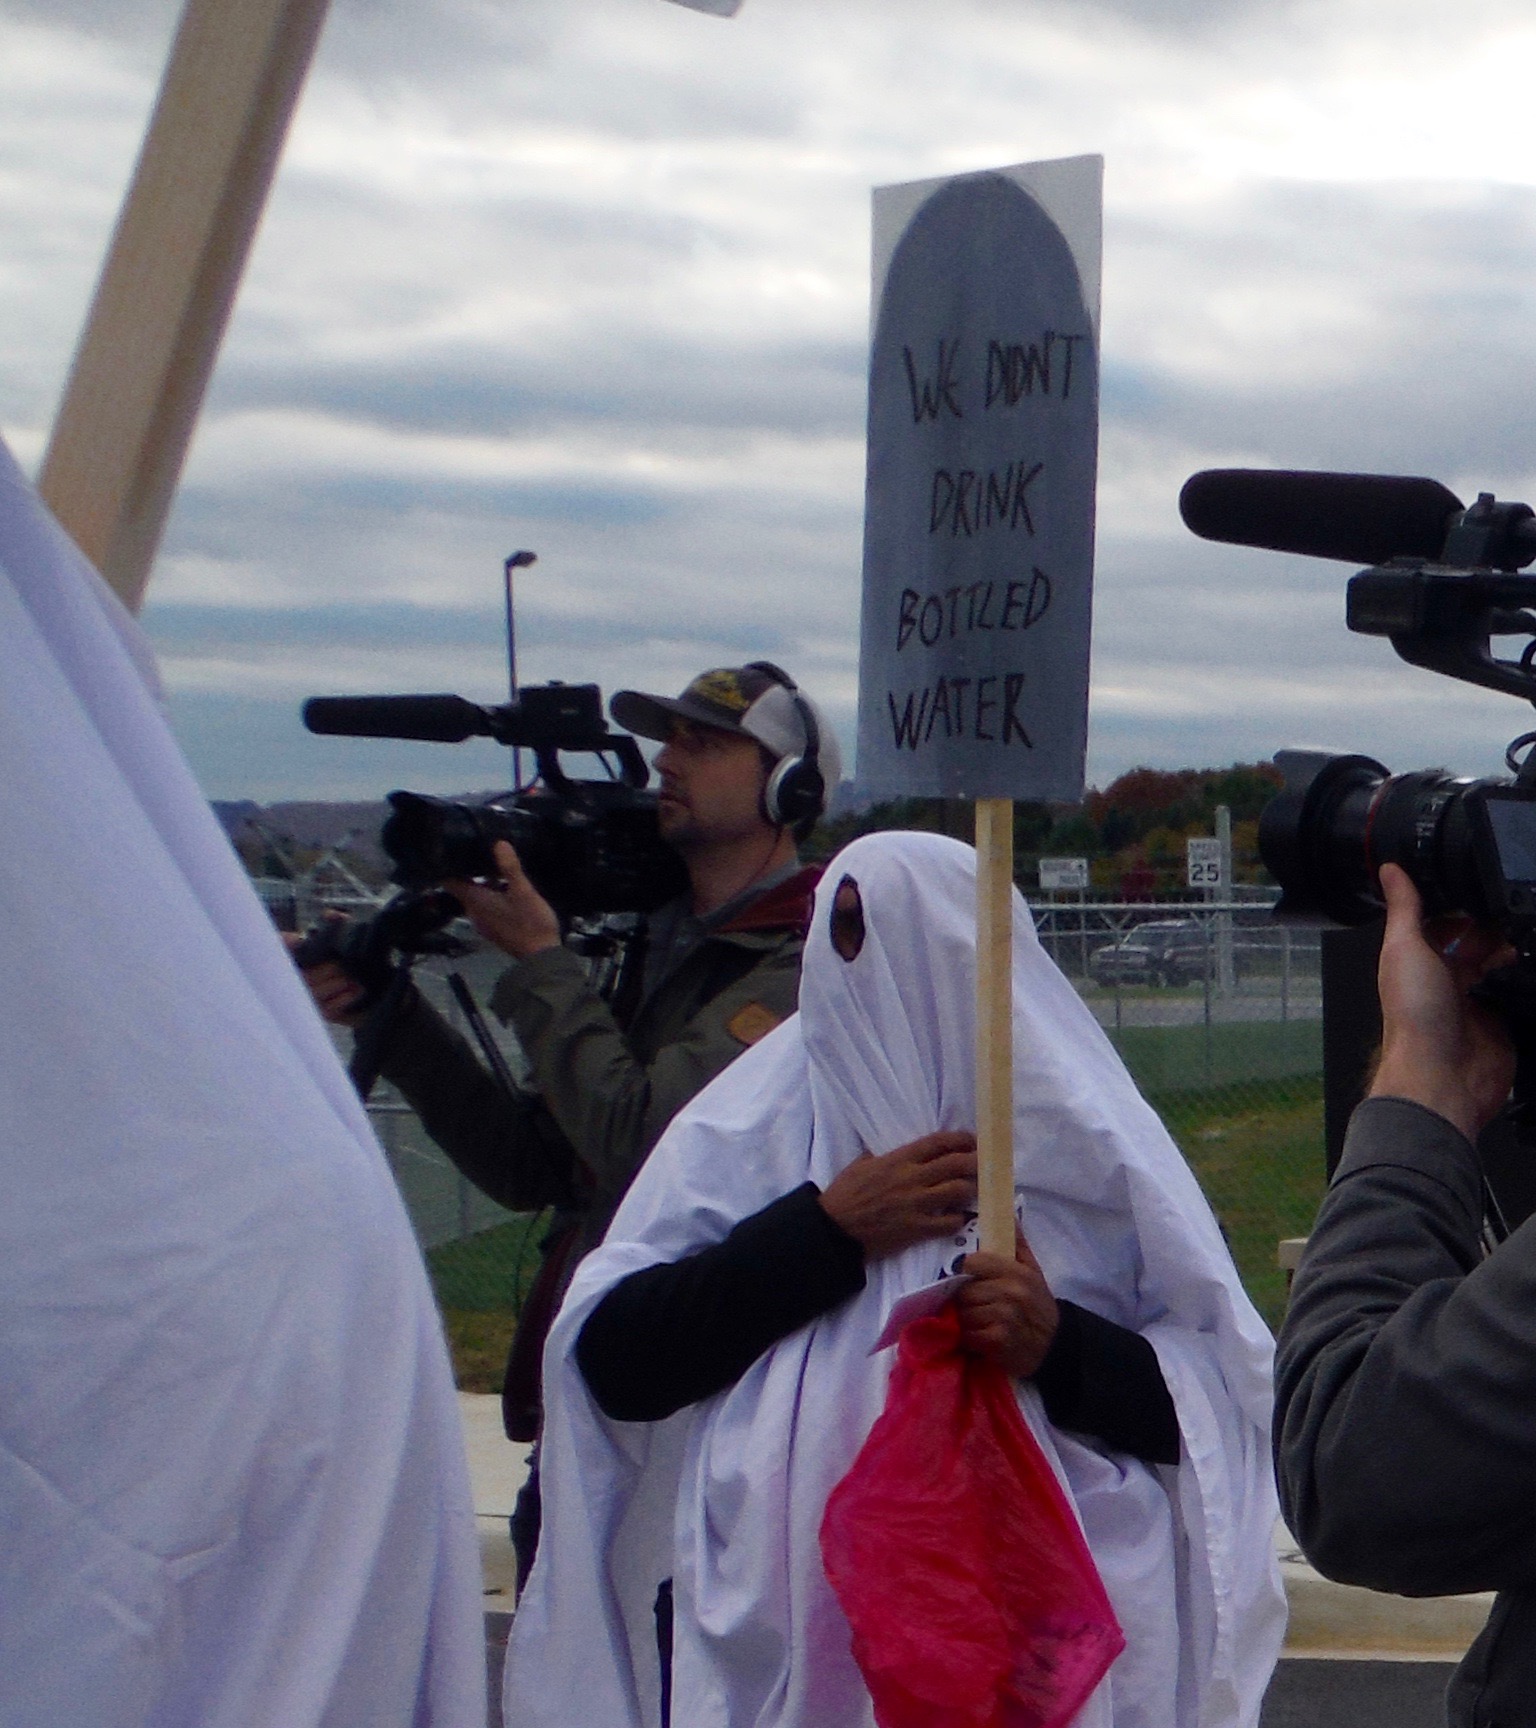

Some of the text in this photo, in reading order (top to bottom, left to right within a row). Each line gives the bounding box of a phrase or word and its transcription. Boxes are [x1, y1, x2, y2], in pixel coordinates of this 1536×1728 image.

[903, 338, 963, 422] WE
[929, 463, 1044, 536] DRINK
[896, 568, 1053, 652] BOTTLED
[887, 674, 1033, 750] WATER
[1191, 863, 1219, 882] 25
